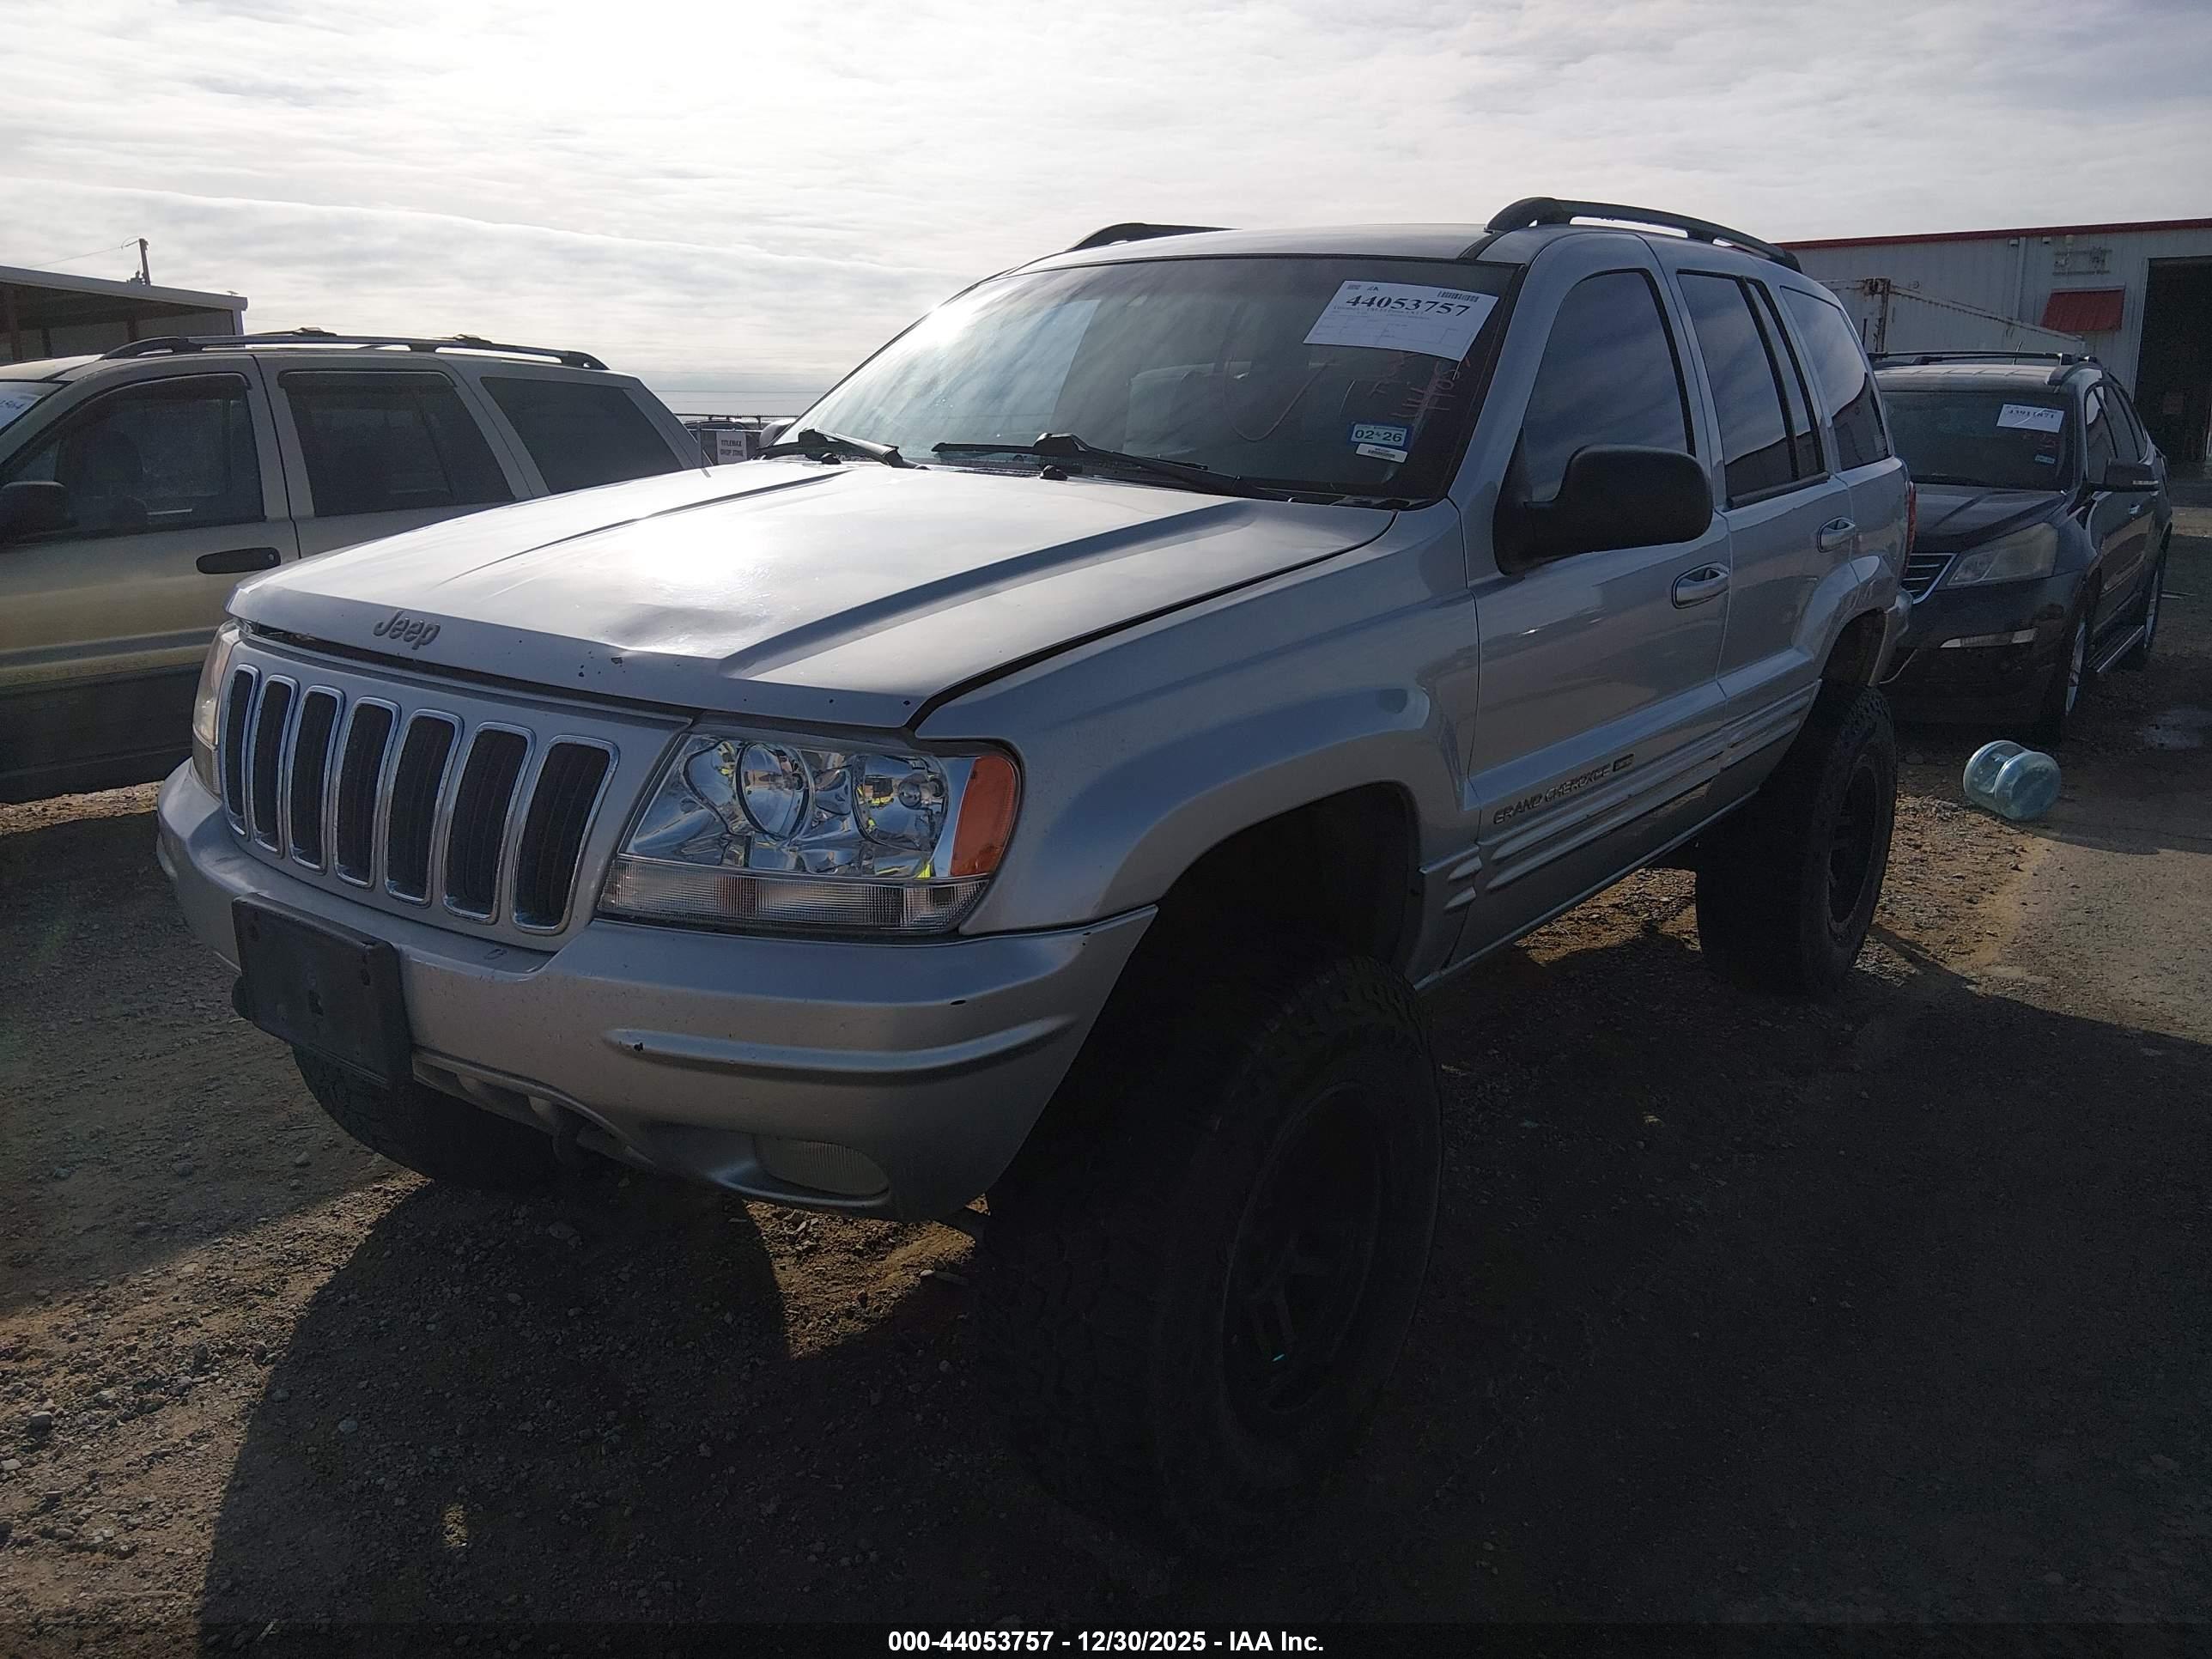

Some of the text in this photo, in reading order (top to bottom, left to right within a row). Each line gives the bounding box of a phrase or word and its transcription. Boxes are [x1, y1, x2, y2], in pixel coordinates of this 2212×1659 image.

[1346, 295, 1471, 317] 44053757
[373, 610, 441, 650] Jeep
[1493, 763, 1612, 824] GRAND CHEROKEE
